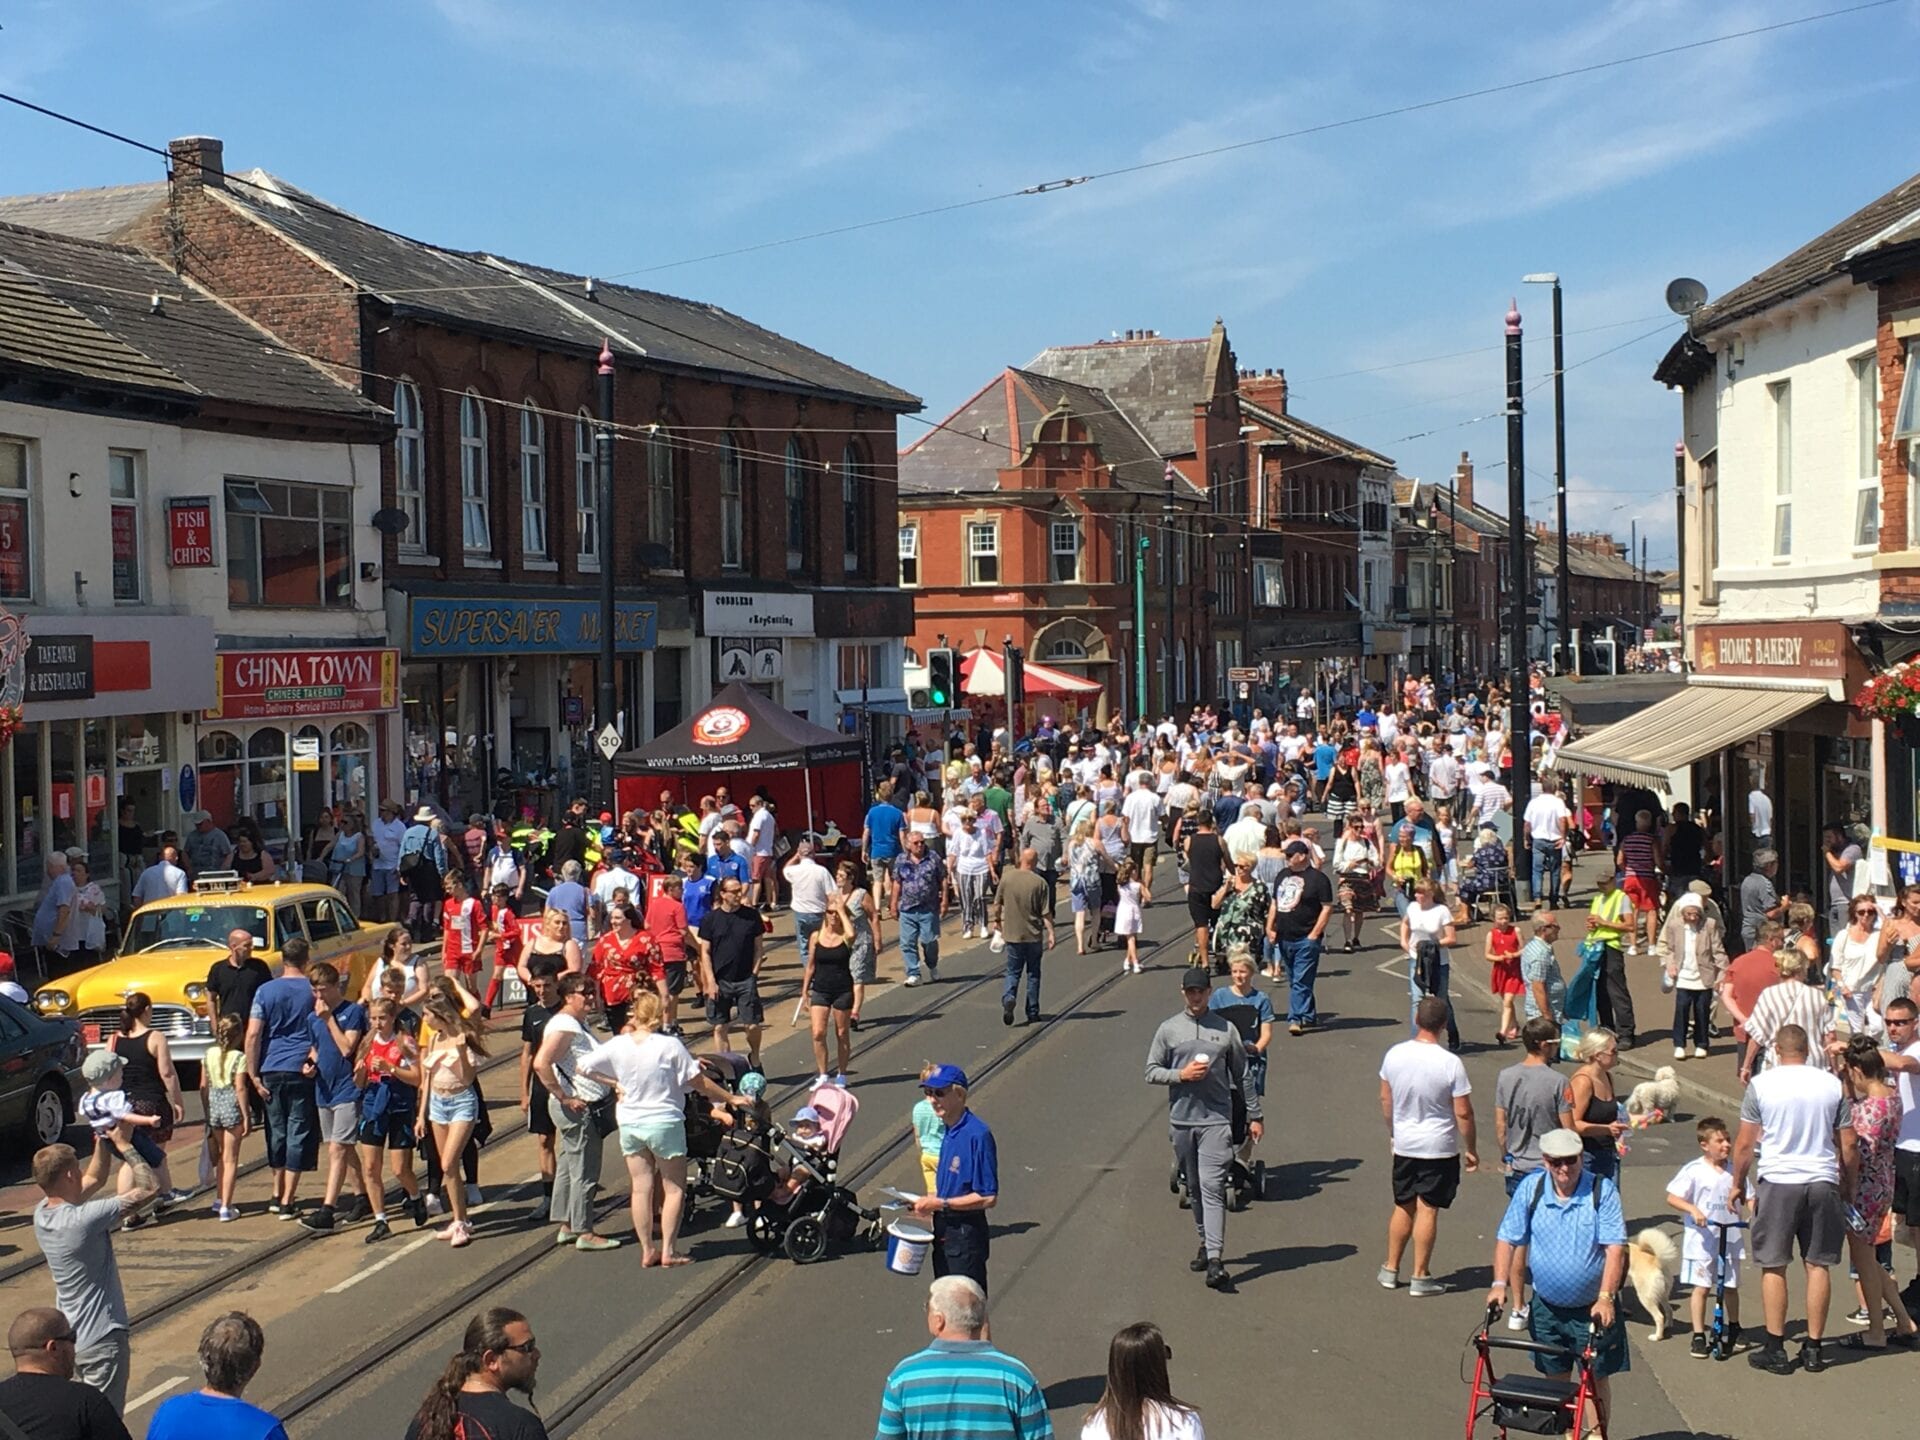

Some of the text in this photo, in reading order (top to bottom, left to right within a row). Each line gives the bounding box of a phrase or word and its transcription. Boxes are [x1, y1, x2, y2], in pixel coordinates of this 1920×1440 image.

[176, 511, 206, 528] FISH
[187, 529, 197, 546] &
[174, 547, 211, 564] CHIPS
[421, 608, 654, 646] SUPERSAVER MRKET
[38, 645, 77, 664] TAKEAWAY
[1719, 637, 1753, 665] HOME
[1755, 637, 1803, 666] BAKERY
[235, 657, 303, 688] CHINA
[307, 655, 373, 685] TOWN
[30, 674, 37, 692] &
[38, 671, 86, 692] RESTAURANT
[267, 687, 342, 700] CHINESE TAKEAWAY
[265, 702, 294, 714] Delivery
[295, 701, 320, 712] Service
[601, 736, 619, 747] 30
[647, 753, 760, 767] www.nwbb-lancs.org
